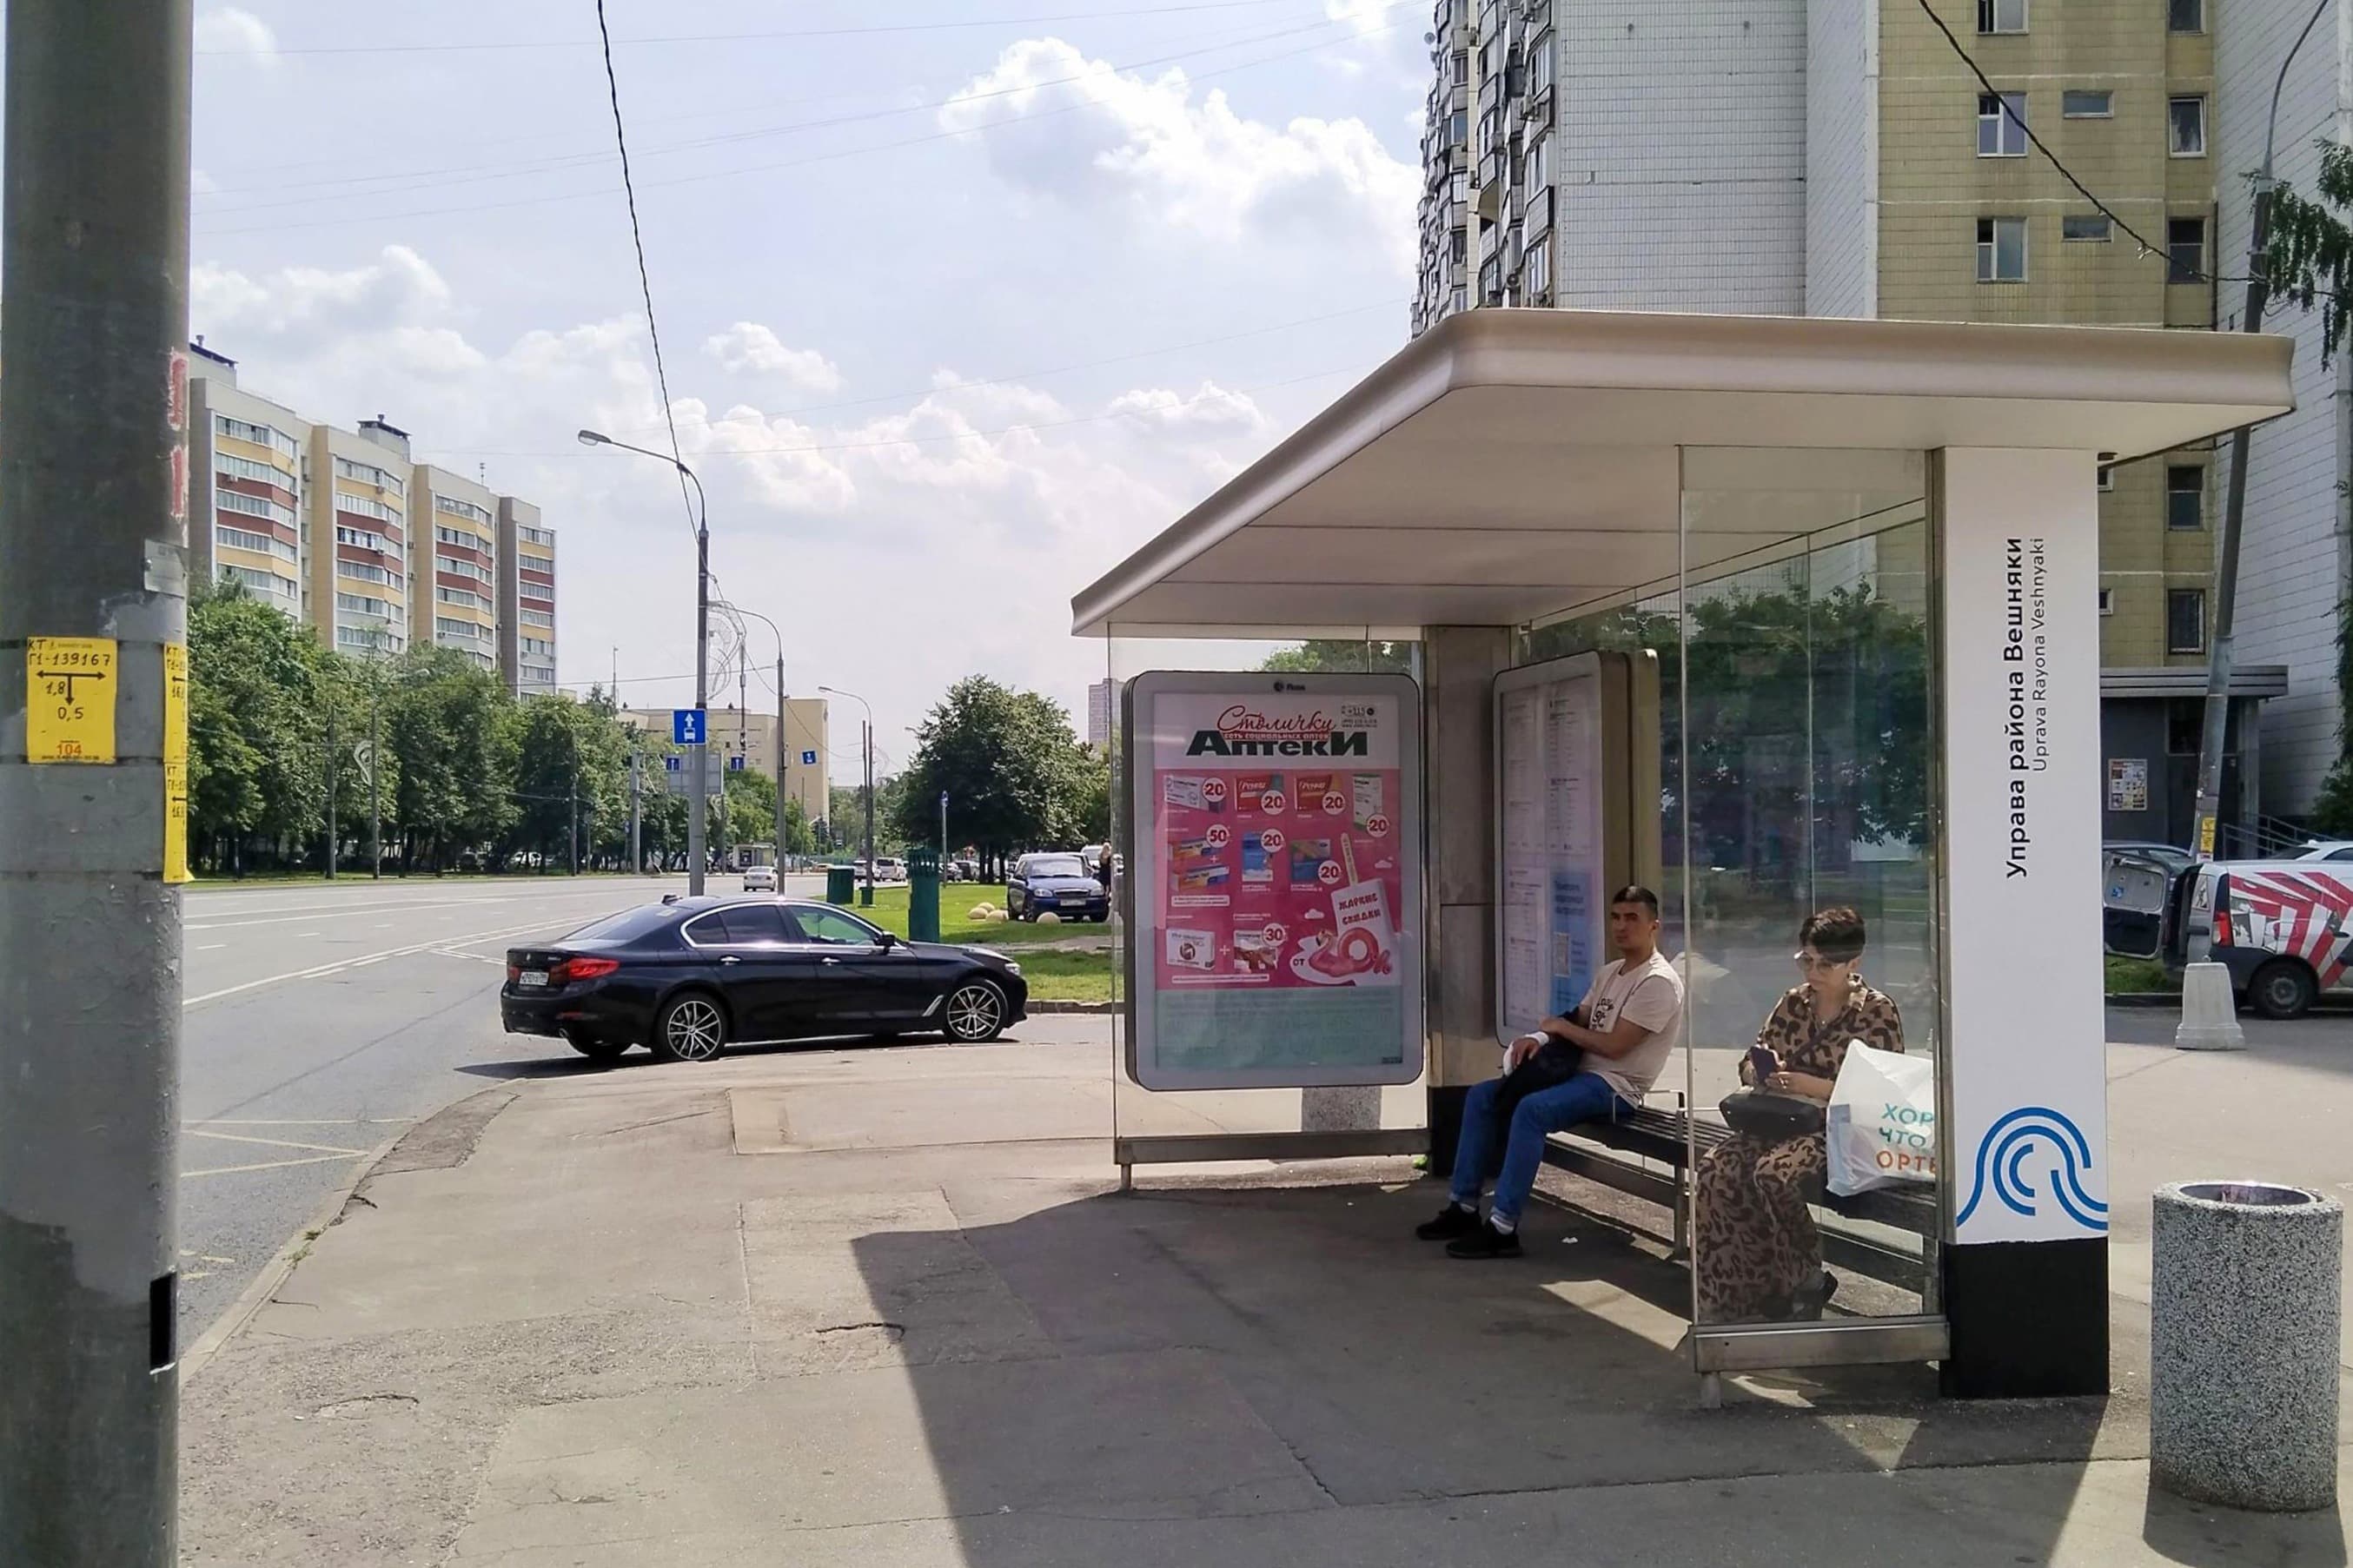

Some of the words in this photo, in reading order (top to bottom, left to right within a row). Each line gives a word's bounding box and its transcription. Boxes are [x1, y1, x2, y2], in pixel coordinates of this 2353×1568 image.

[2004, 539, 2023, 661] Вешняки
[2030, 539, 2047, 630] Veshnyaki
[46, 681, 66, 696] 1,8
[2032, 636, 2049, 700] Rayona
[57, 707, 84, 722] 0,5
[1217, 705, 1336, 732] Столички
[2004, 672, 2030, 771] района
[2033, 707, 2050, 771] Uprava
[56, 744, 82, 756] 104
[2005, 780, 2031, 878] Управа
[1879, 1127, 1926, 1148] ЧТО
